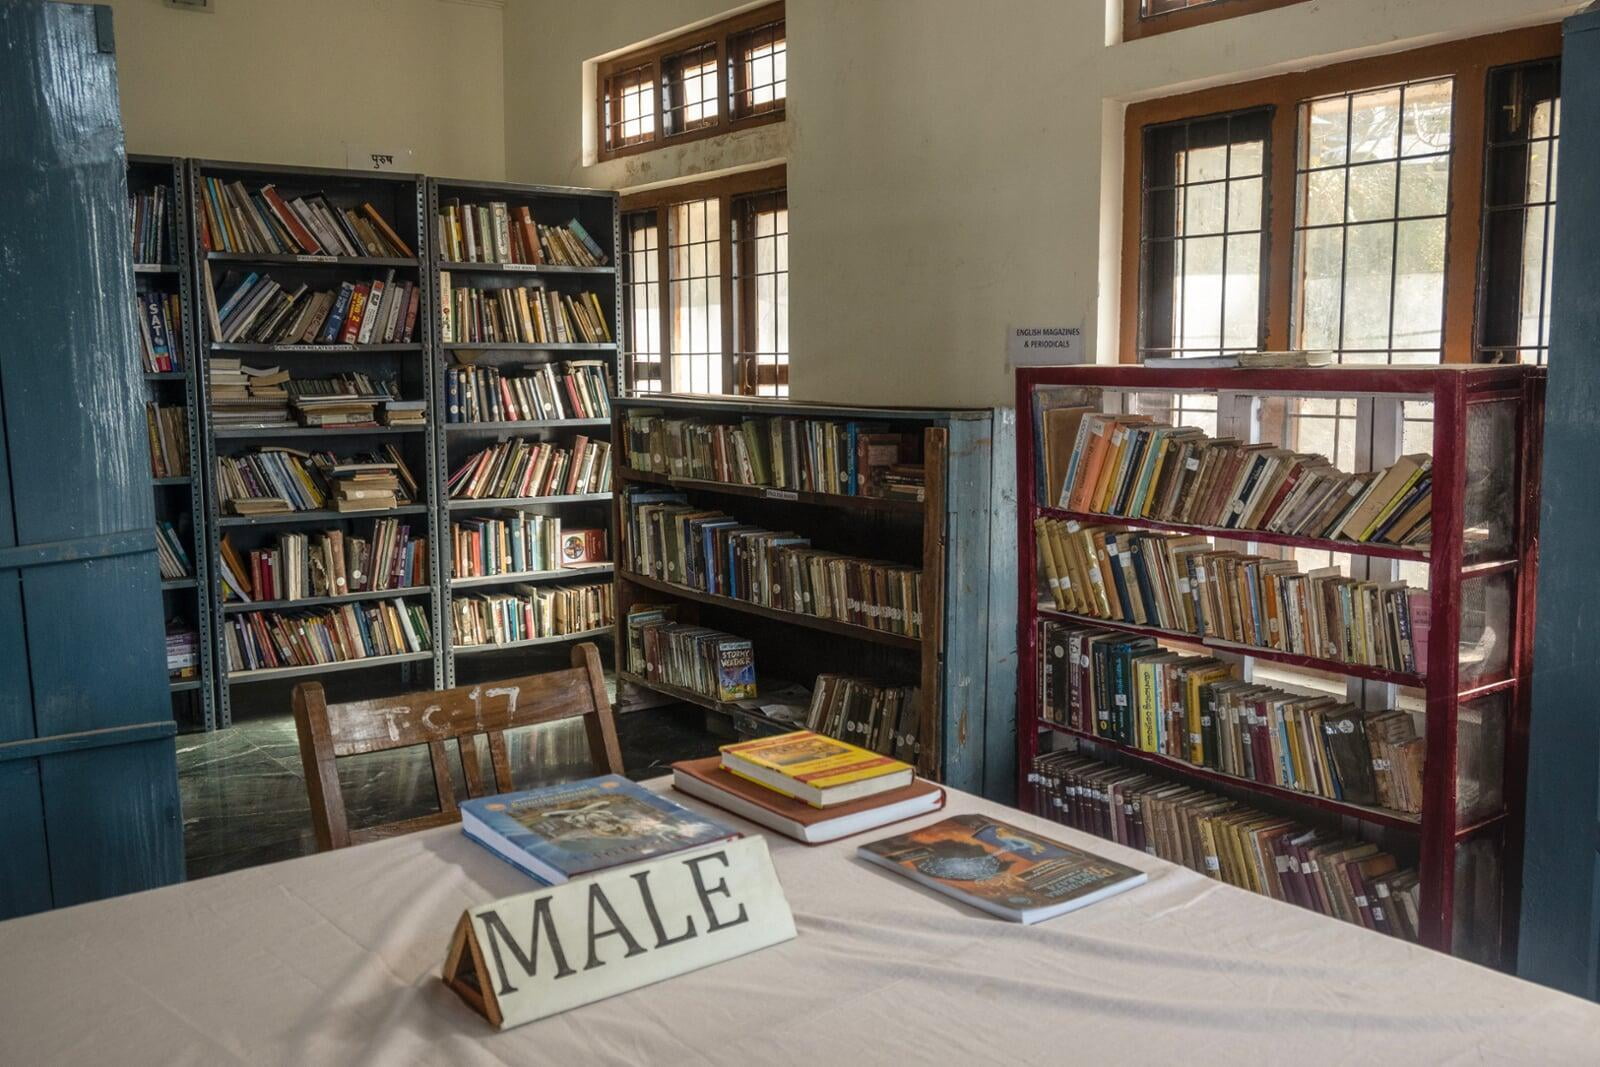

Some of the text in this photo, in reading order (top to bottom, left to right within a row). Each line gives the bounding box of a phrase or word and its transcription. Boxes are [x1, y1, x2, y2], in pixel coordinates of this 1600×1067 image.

[371, 154, 393, 169] पुरुष
[1016, 328, 1080, 336] ENGLISH MAGAZINES
[1024, 340, 1070, 348] & PERIODICALS
[476, 850, 750, 997] MALE
